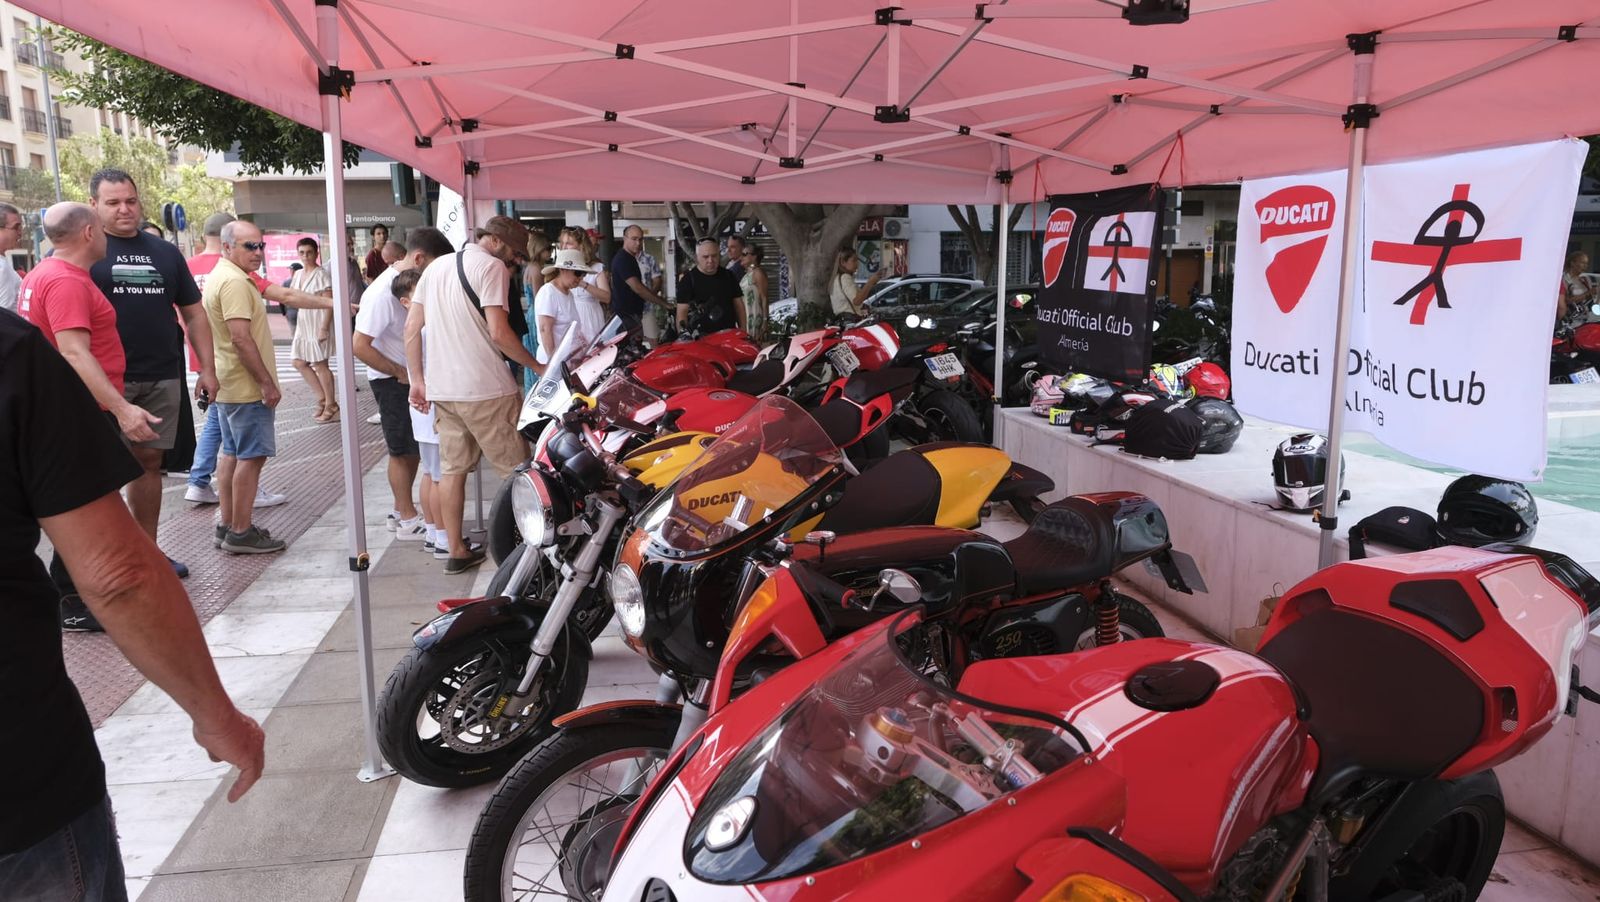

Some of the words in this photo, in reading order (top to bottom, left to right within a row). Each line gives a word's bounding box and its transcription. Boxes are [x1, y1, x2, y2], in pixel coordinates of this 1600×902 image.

[1260, 201, 1329, 225] DUCATI
[116, 255, 128, 263] AS
[130, 255, 152, 264] FREE
[113, 286, 124, 294] AS
[1062, 308, 1102, 331] Official
[1105, 315, 1133, 337] Club
[1244, 341, 1319, 375] Ducati
[1407, 368, 1486, 406] Club
[688, 490, 742, 511] DUCAT
[996, 630, 1023, 650] 250
